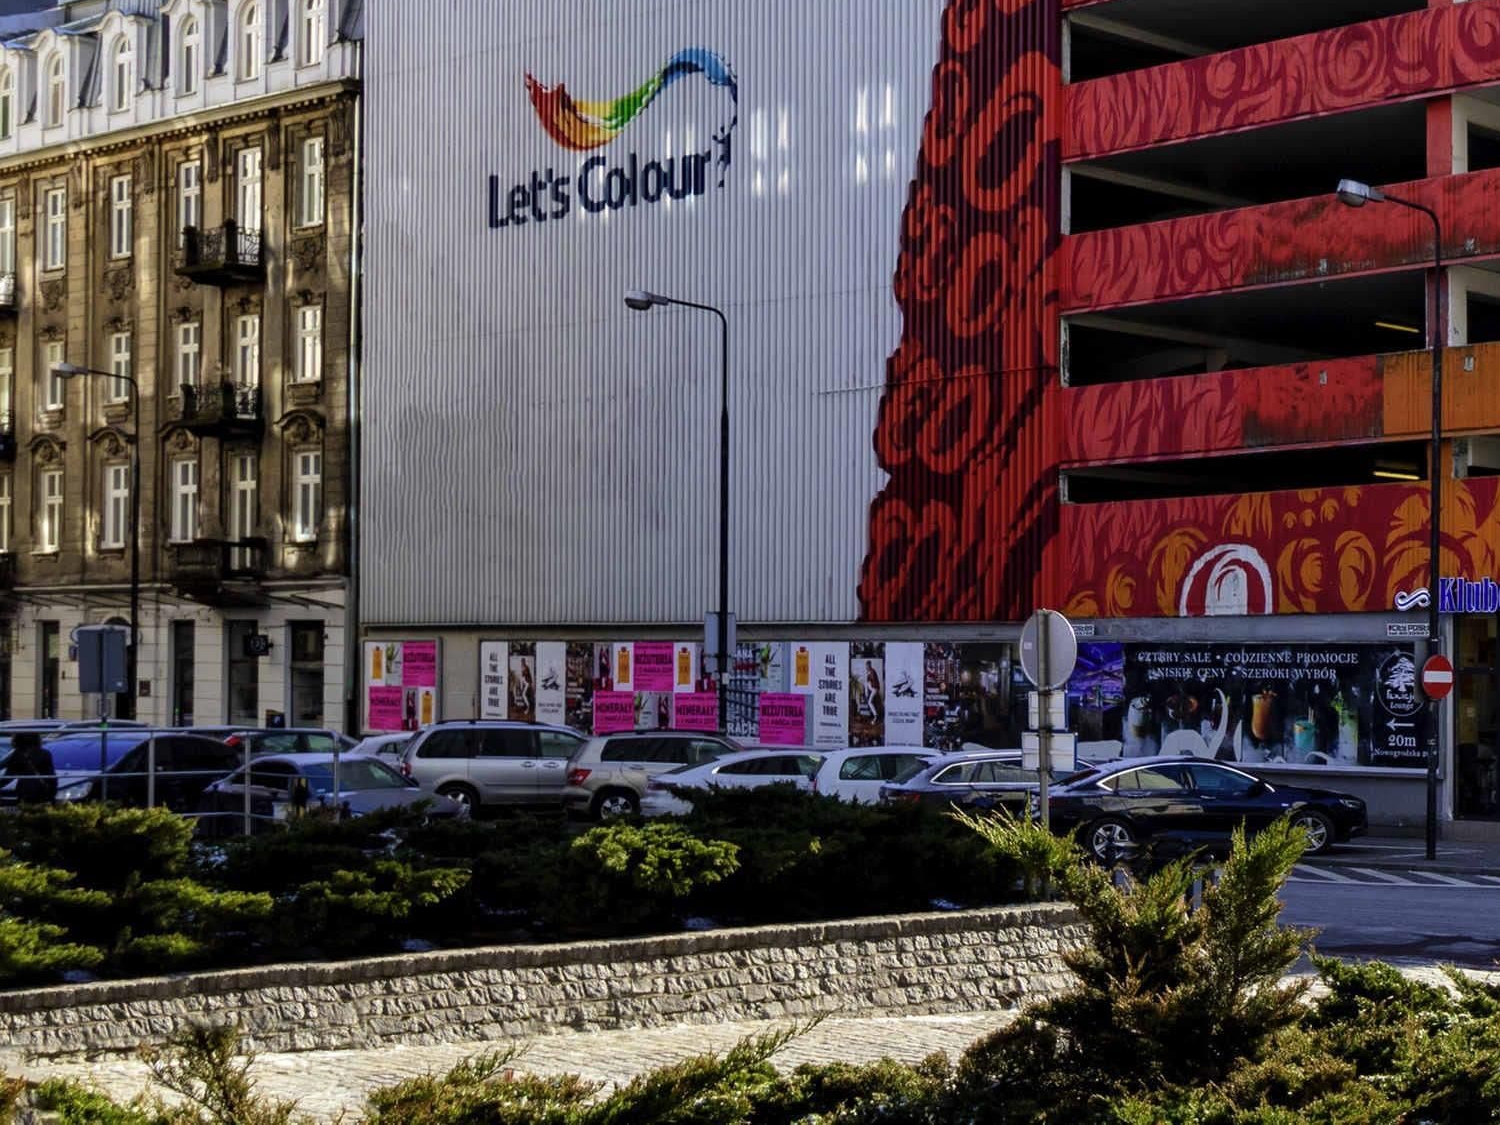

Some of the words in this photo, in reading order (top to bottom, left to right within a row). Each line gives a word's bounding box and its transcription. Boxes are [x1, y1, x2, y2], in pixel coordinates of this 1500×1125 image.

[488, 167, 570, 229] Let's
[578, 151, 711, 213] Colour
[825, 654, 836, 664] ALL
[1184, 652, 1212, 663] SALE
[1225, 651, 1292, 664] CODZIENNE
[1296, 652, 1359, 664] PROMOCJE
[825, 667, 836, 677] THE
[1197, 667, 1227, 679] CENY
[1241, 667, 1289, 679] SZEROKI
[824, 693, 836, 703] ARE
[1388, 734, 1416, 747] 20m
